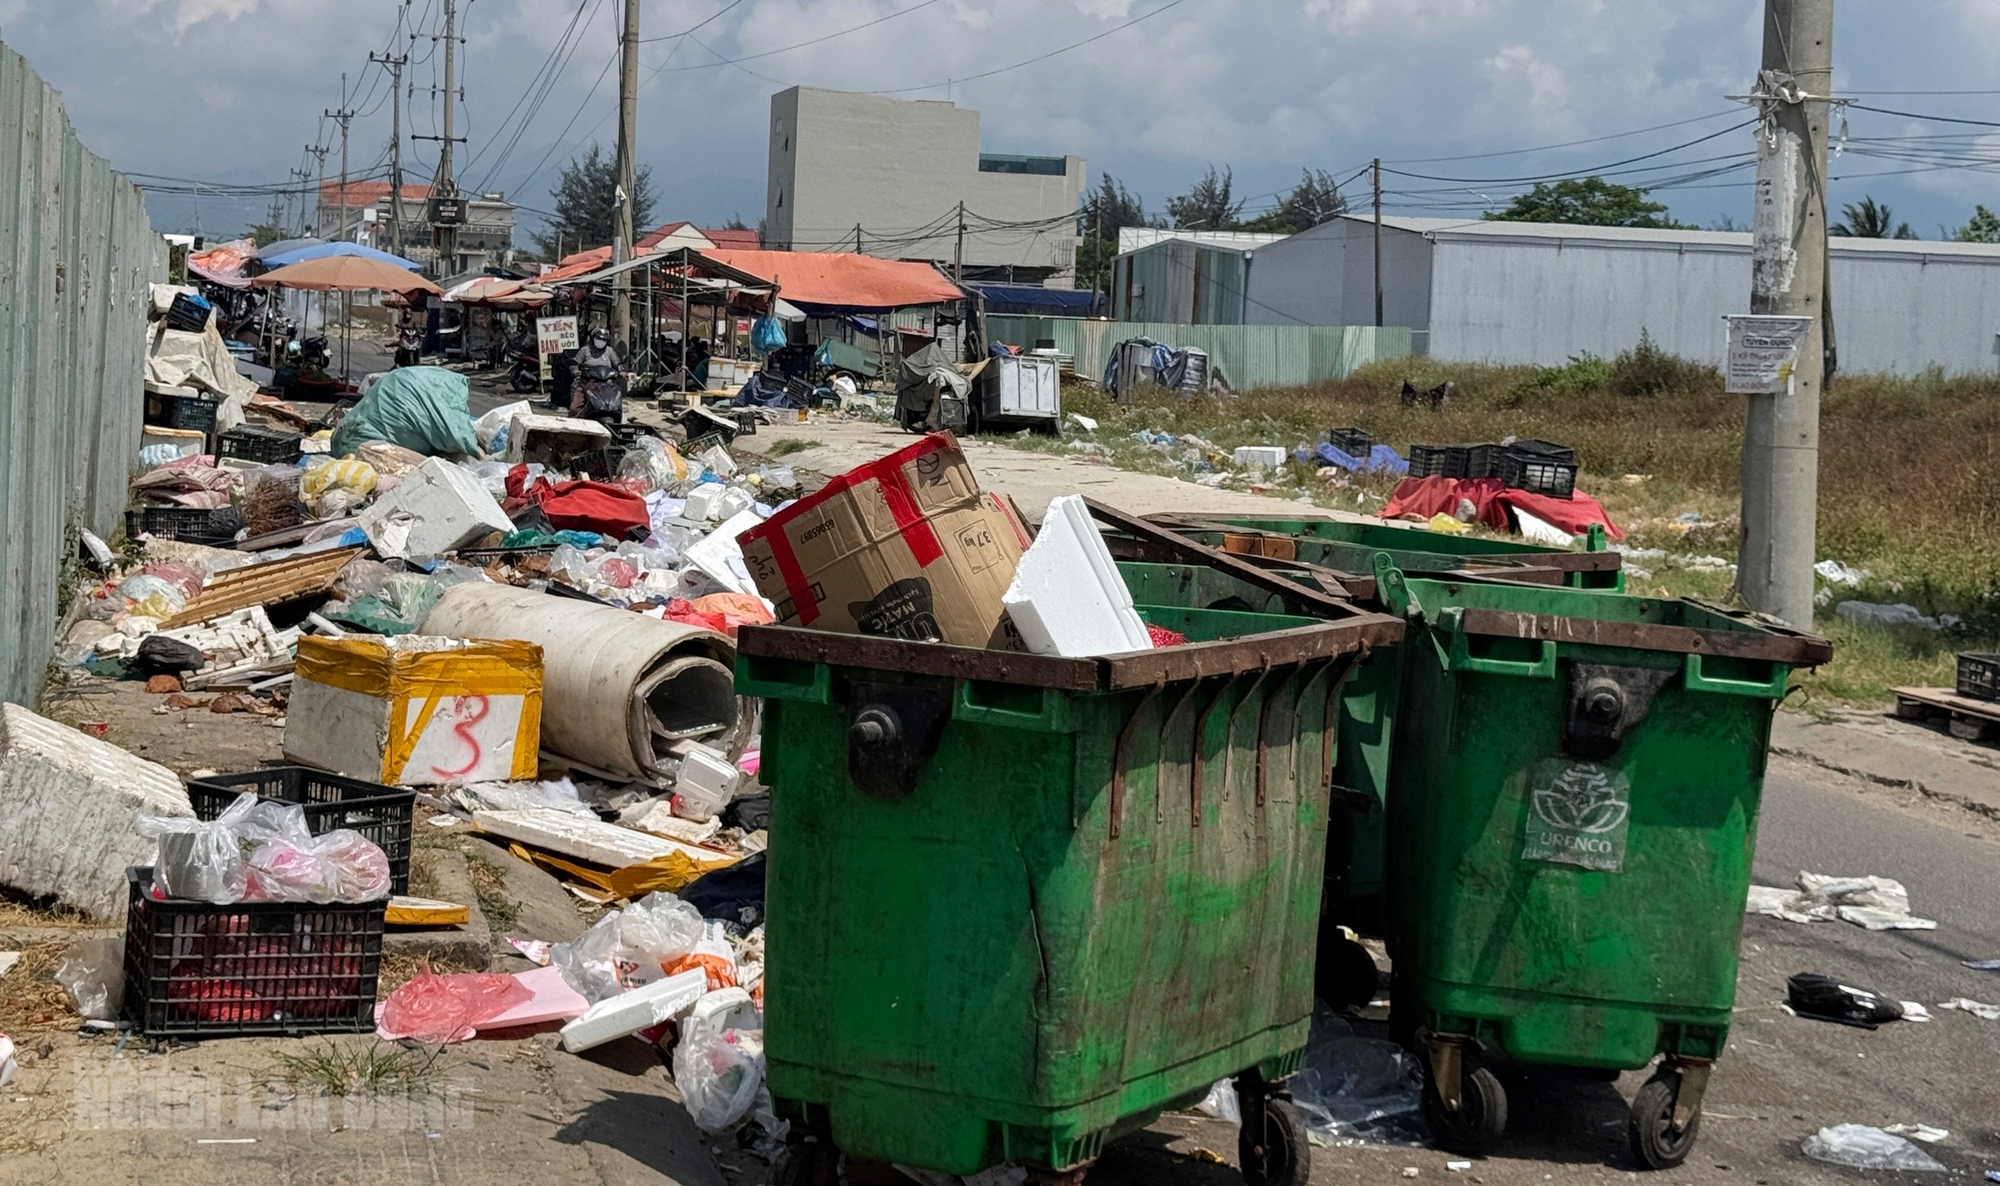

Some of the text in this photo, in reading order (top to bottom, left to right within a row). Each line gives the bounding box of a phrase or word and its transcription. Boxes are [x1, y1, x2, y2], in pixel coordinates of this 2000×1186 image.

[800, 518, 835, 545] 65065897
[431, 693, 489, 777] 3
[1540, 832, 1612, 854] URENCO
